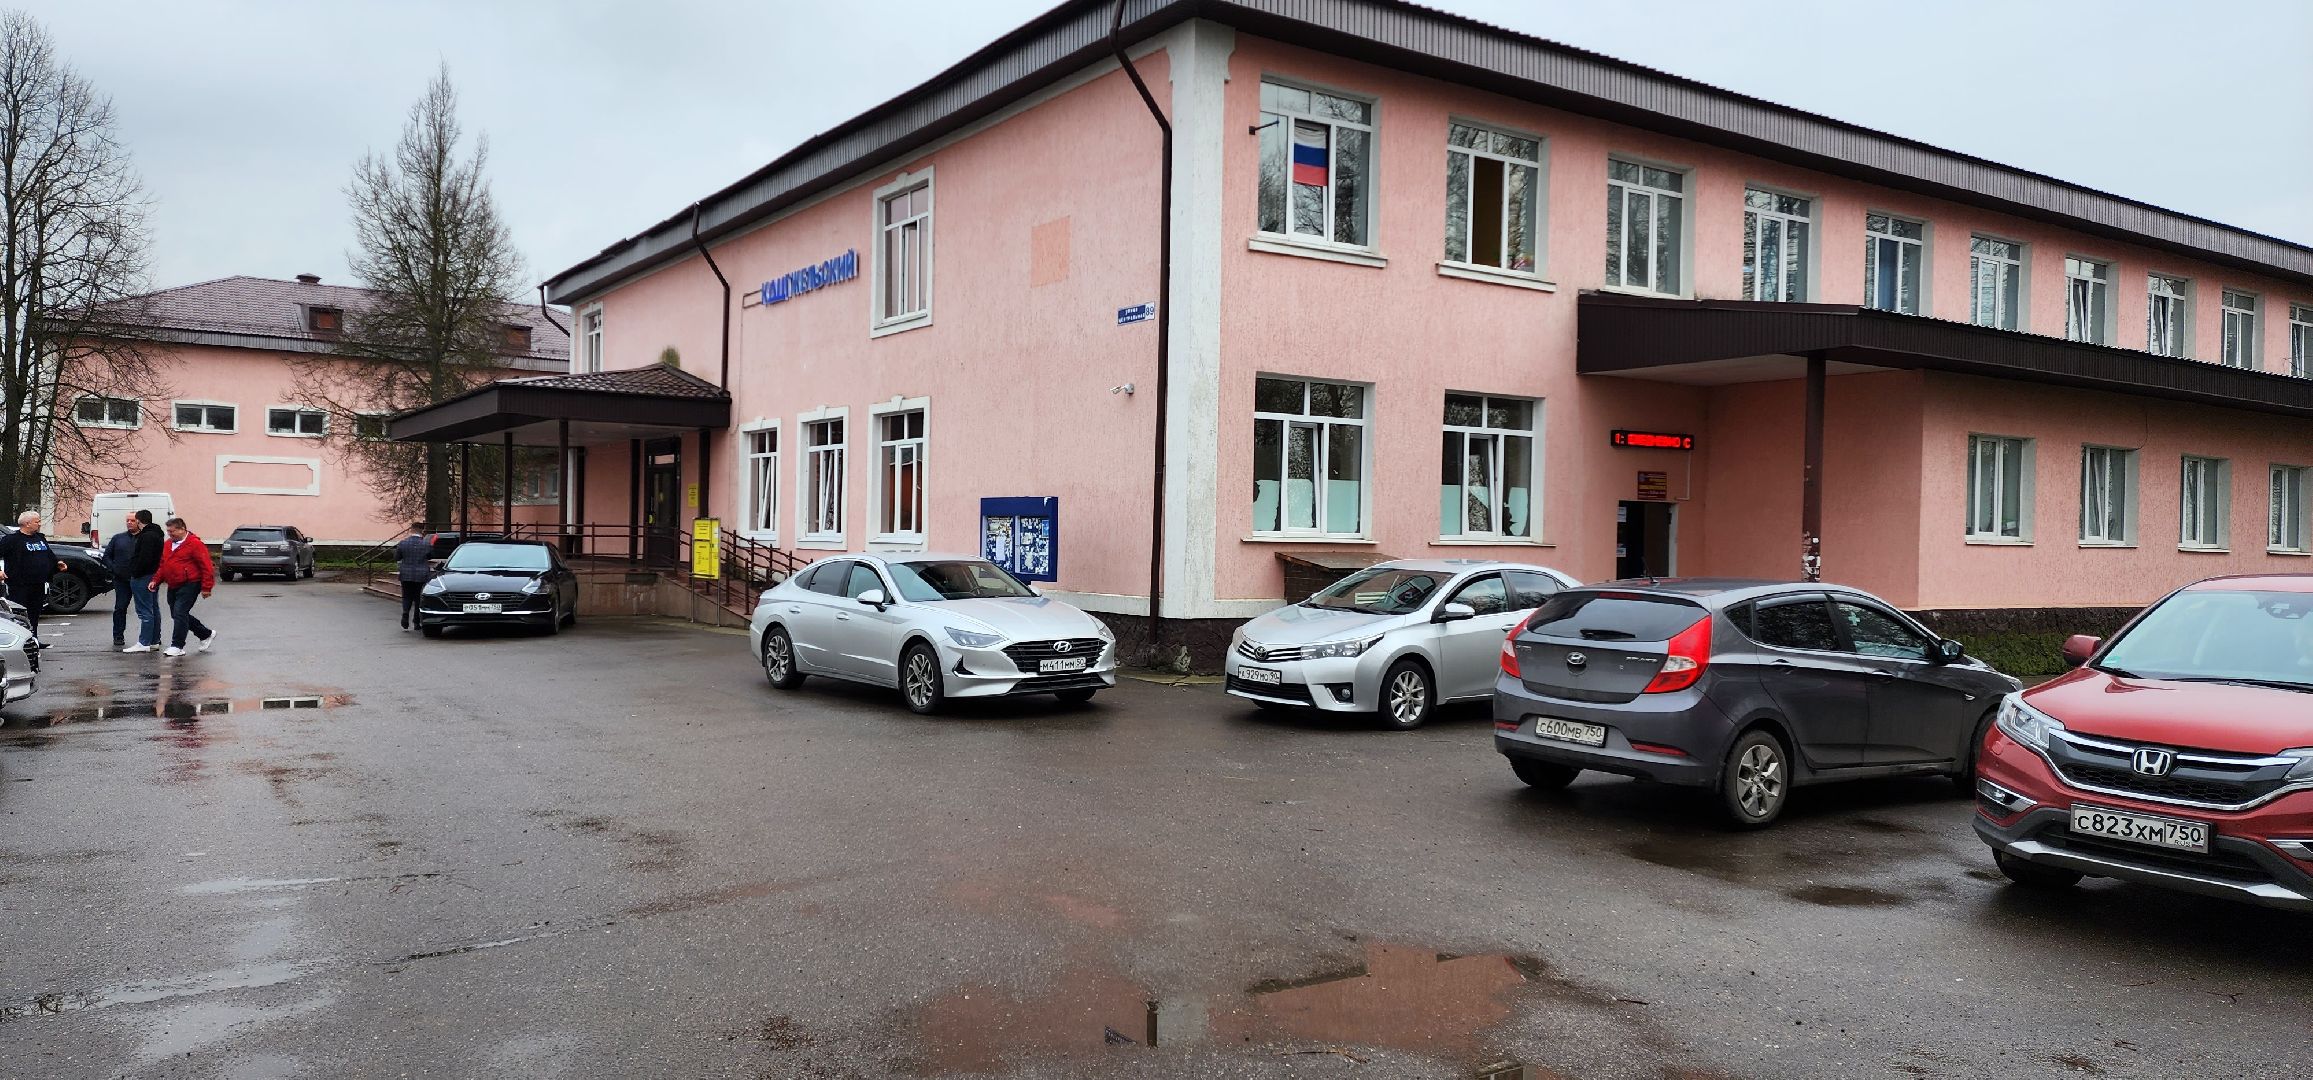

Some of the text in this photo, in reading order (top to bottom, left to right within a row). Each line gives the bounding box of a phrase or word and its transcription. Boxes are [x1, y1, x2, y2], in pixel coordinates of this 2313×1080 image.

[1146, 306, 1155, 317] 89
[1585, 725, 1602, 738] 750
[2077, 813, 2201, 843] С823ХМ 750
